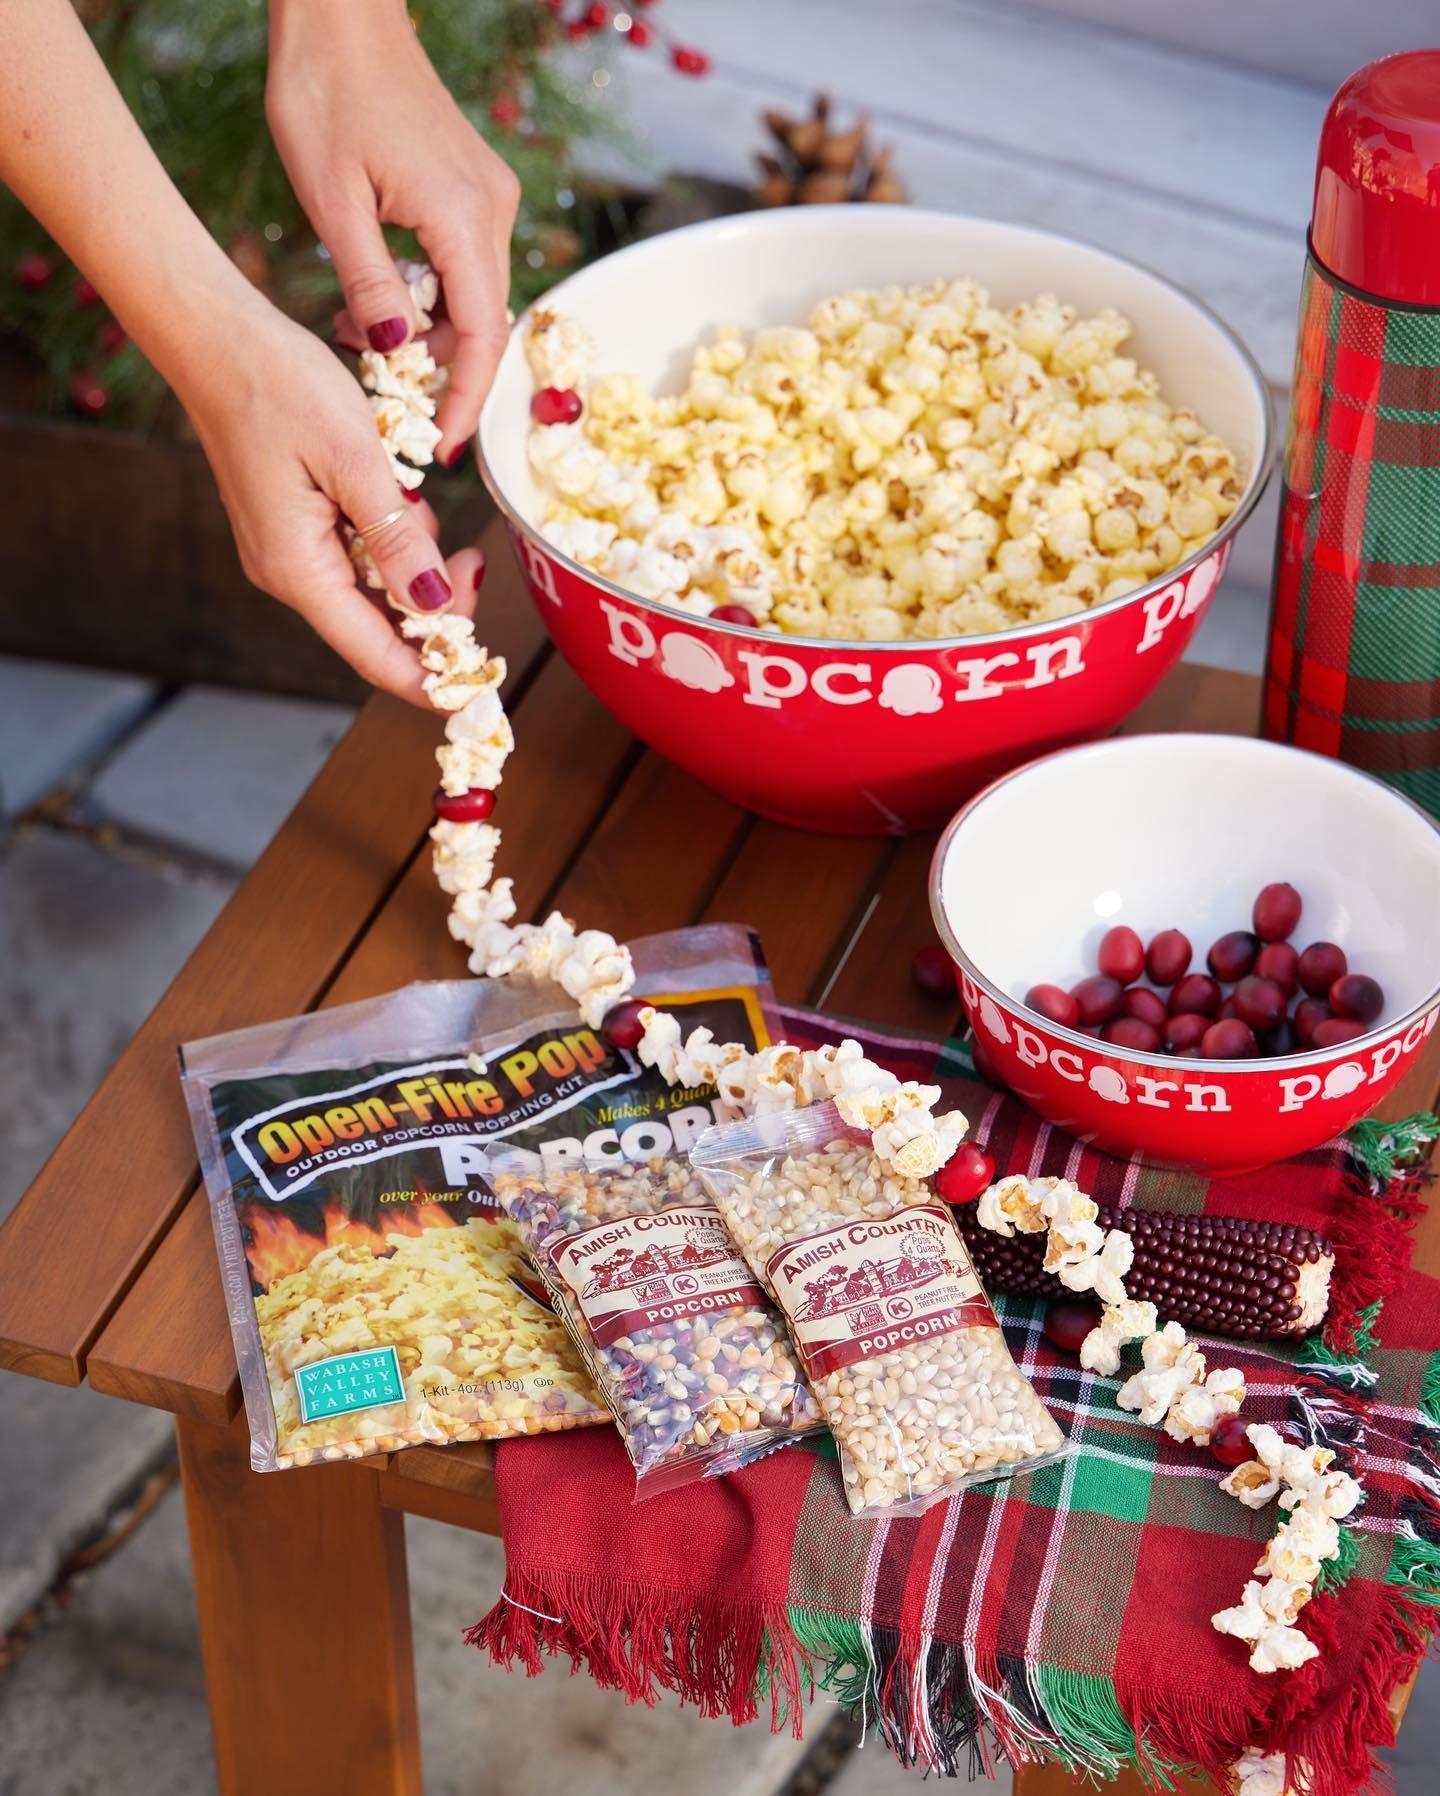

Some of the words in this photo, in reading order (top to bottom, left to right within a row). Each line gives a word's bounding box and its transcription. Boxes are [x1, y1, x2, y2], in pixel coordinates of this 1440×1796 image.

[257, 1077, 505, 1165] Open-Fire
[500, 1029, 606, 1098] Pop
[597, 1102, 650, 1125] Makes
[655, 1093, 667, 1111] 4
[286, 1139, 379, 1178] OUTDOOR
[382, 1122, 471, 1145] POPCORN
[474, 1092, 553, 1132] POPPING
[556, 1074, 585, 1097] KIT
[379, 1189, 418, 1204] over
[421, 1190, 463, 1206] your
[568, 1226, 632, 1266] AMISH
[695, 1230, 716, 1238] Pops
[782, 1238, 847, 1284] AMISH
[848, 1218, 946, 1246] COUNTRY
[700, 1270, 727, 1280] PEANUT
[727, 1268, 745, 1276] FREE
[704, 1278, 720, 1286] TREE
[719, 1275, 735, 1284] NUT
[735, 1273, 752, 1281] FREE
[645, 1290, 744, 1323] POPCORN
[914, 1287, 942, 1302] PEANUT
[942, 1284, 960, 1293] FREE
[917, 1299, 936, 1309] TREE
[935, 1295, 951, 1304] NUT
[950, 1291, 967, 1300] FREE
[858, 1312, 960, 1355] POPCORN
[304, 1356, 387, 1383] WABASH
[307, 1370, 392, 1397] VALLEY
[484, 1378, 525, 1395] (113g)
[311, 1384, 394, 1412] FARMS
